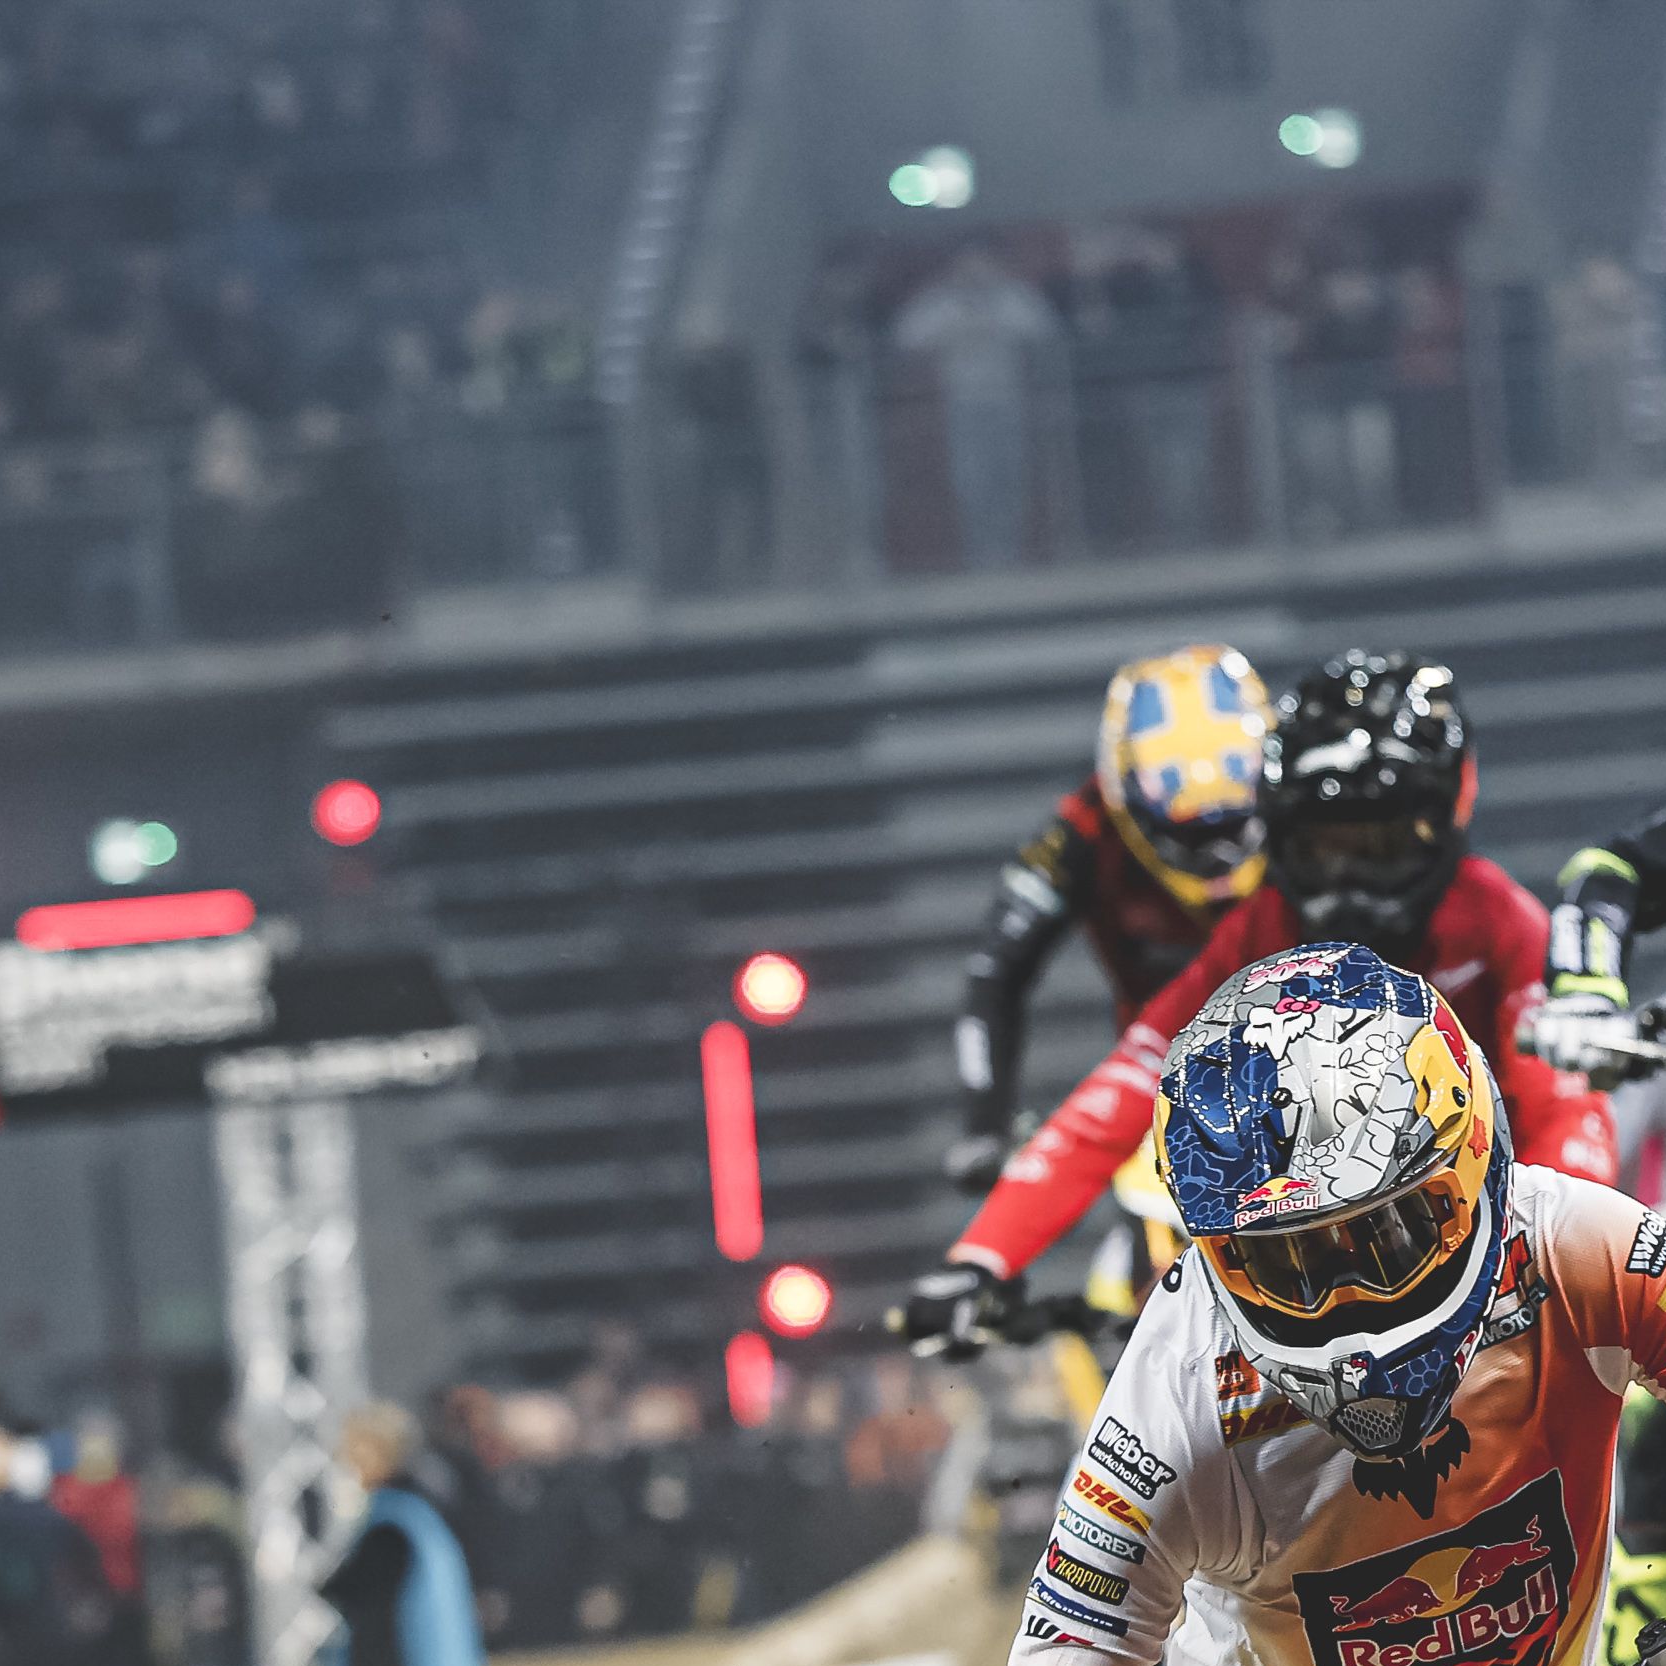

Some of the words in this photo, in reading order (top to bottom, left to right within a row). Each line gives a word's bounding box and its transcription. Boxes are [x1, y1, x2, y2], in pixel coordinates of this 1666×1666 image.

[1234, 1200, 1275, 1228] Red
[1274, 1190, 1320, 1217] Bull
[1099, 1417, 1173, 1485] Weber
[1073, 1469, 1136, 1526] DHL
[1065, 1508, 1138, 1560] MOTOREX
[1455, 1562, 1559, 1652] Bull
